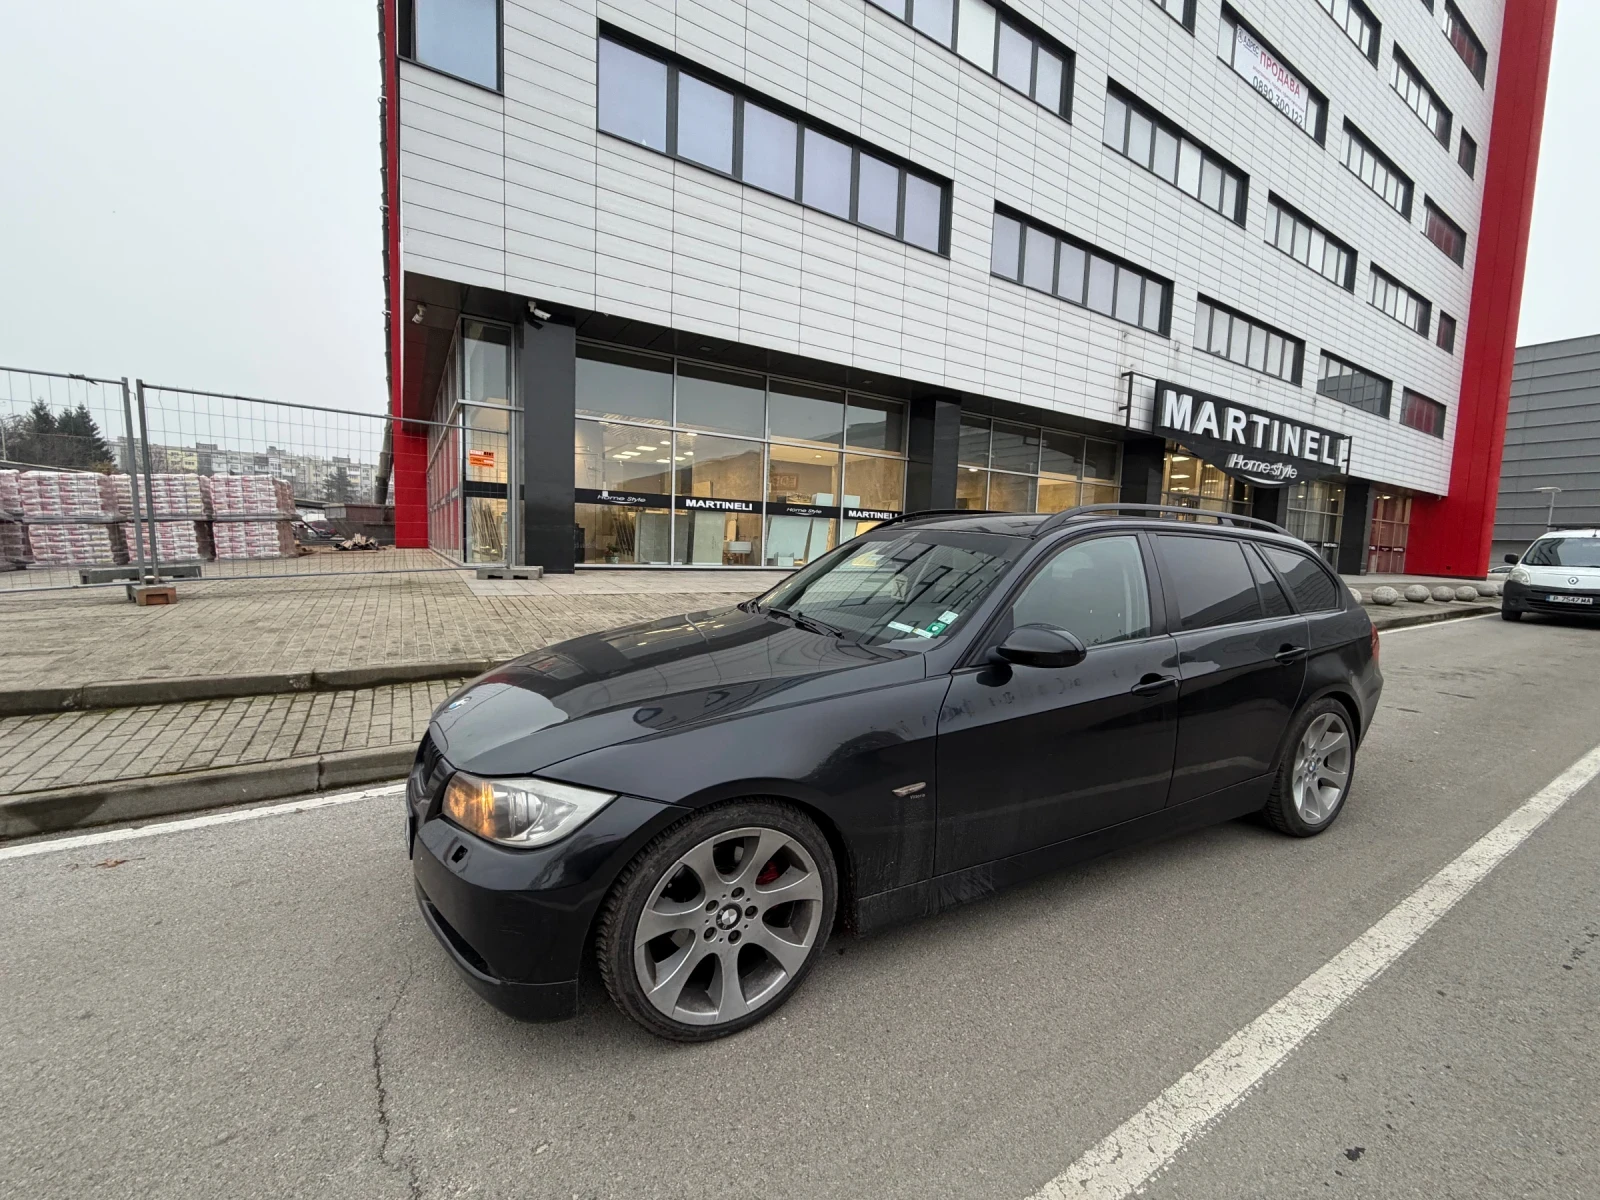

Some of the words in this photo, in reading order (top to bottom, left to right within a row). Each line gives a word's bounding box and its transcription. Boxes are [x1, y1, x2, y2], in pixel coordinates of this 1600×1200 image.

[1260, 50, 1300, 99] ПРОДАВА
[1253, 75, 1274, 103] 0890
[1275, 94, 1290, 116] 300
[1161, 389, 1345, 467] MARTINELI
[597, 494, 626, 502] Home
[685, 498, 753, 511] MARTINELI
